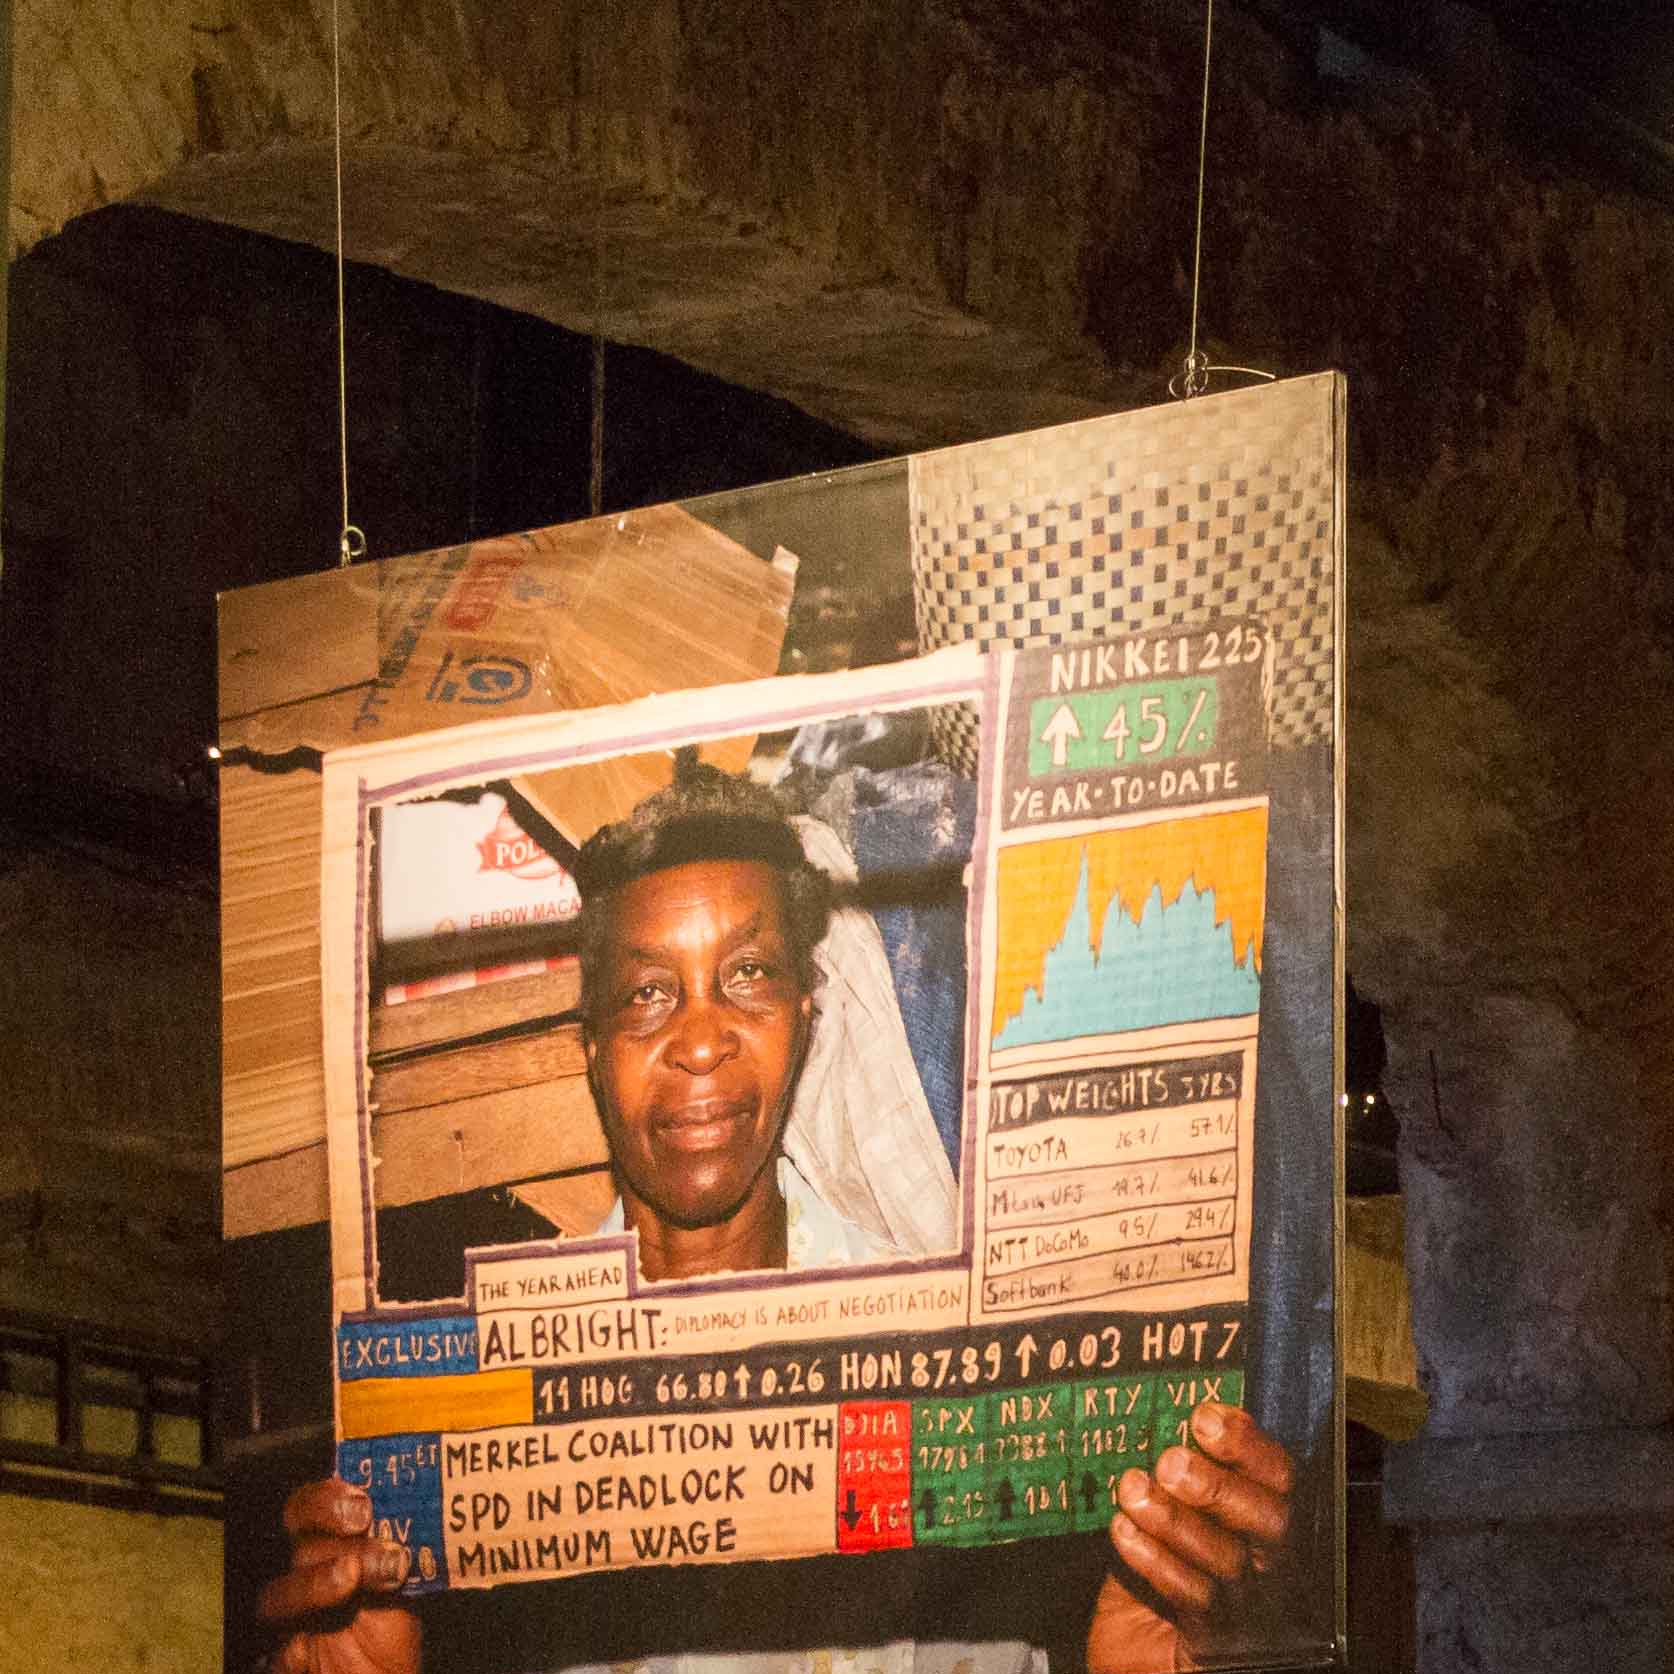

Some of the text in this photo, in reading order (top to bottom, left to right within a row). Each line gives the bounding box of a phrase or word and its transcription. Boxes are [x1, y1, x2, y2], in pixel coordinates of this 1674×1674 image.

[1051, 625, 1262, 693] NIKKEI 225
[470, 905, 529, 929] ELBOW
[999, 1084, 1041, 1124] TOP
[993, 1136, 1067, 1168] TOYOTA
[989, 1236, 1028, 1265] NTT
[480, 1266, 622, 1302] THE YEAR AHEAD
[483, 1307, 667, 1365] ALBRIGHT:
[777, 1300, 830, 1328] ABOUT
[761, 1357, 825, 1397] 0.26
[841, 1350, 902, 1391] HON
[911, 1341, 1001, 1388] 87.89
[1050, 1327, 1122, 1369] 0.03
[1143, 1321, 1208, 1361] HOT
[1217, 1321, 1241, 1359] 7
[1167, 1376, 1222, 1407] VIX
[446, 1416, 834, 1478] MERKEL COALITION WITH
[449, 1462, 814, 1533] SPD IN DEADLOCK ON
[457, 1517, 737, 1577] MINIMUM WAGE
